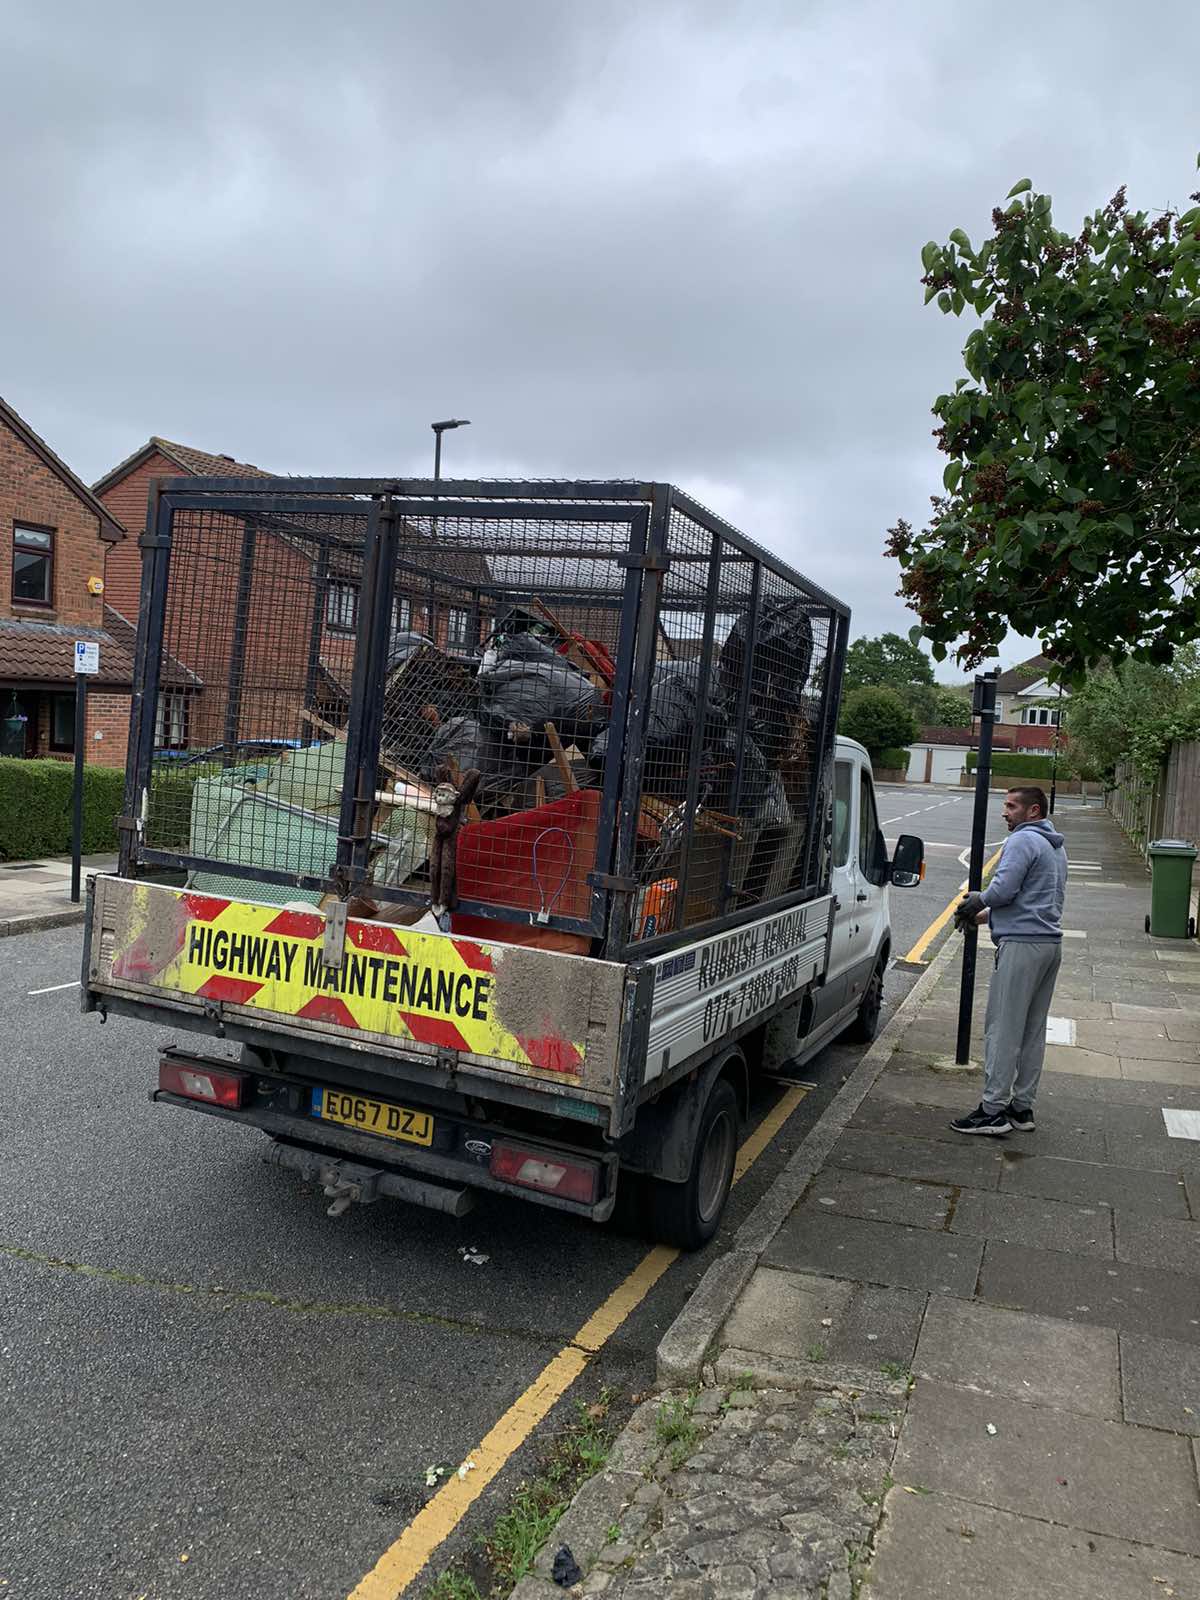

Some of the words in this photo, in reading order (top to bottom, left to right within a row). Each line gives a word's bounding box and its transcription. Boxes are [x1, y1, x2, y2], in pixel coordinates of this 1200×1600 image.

[188, 926, 299, 983] HIGHWAY
[303, 946, 491, 1021] MAINTENANCE
[698, 928, 759, 991] RUBBISH
[762, 908, 807, 961] REMOVAL
[326, 1092, 382, 1126] EO67
[387, 1107, 430, 1139] DZJ
[467, 1141, 491, 1154] Ford
